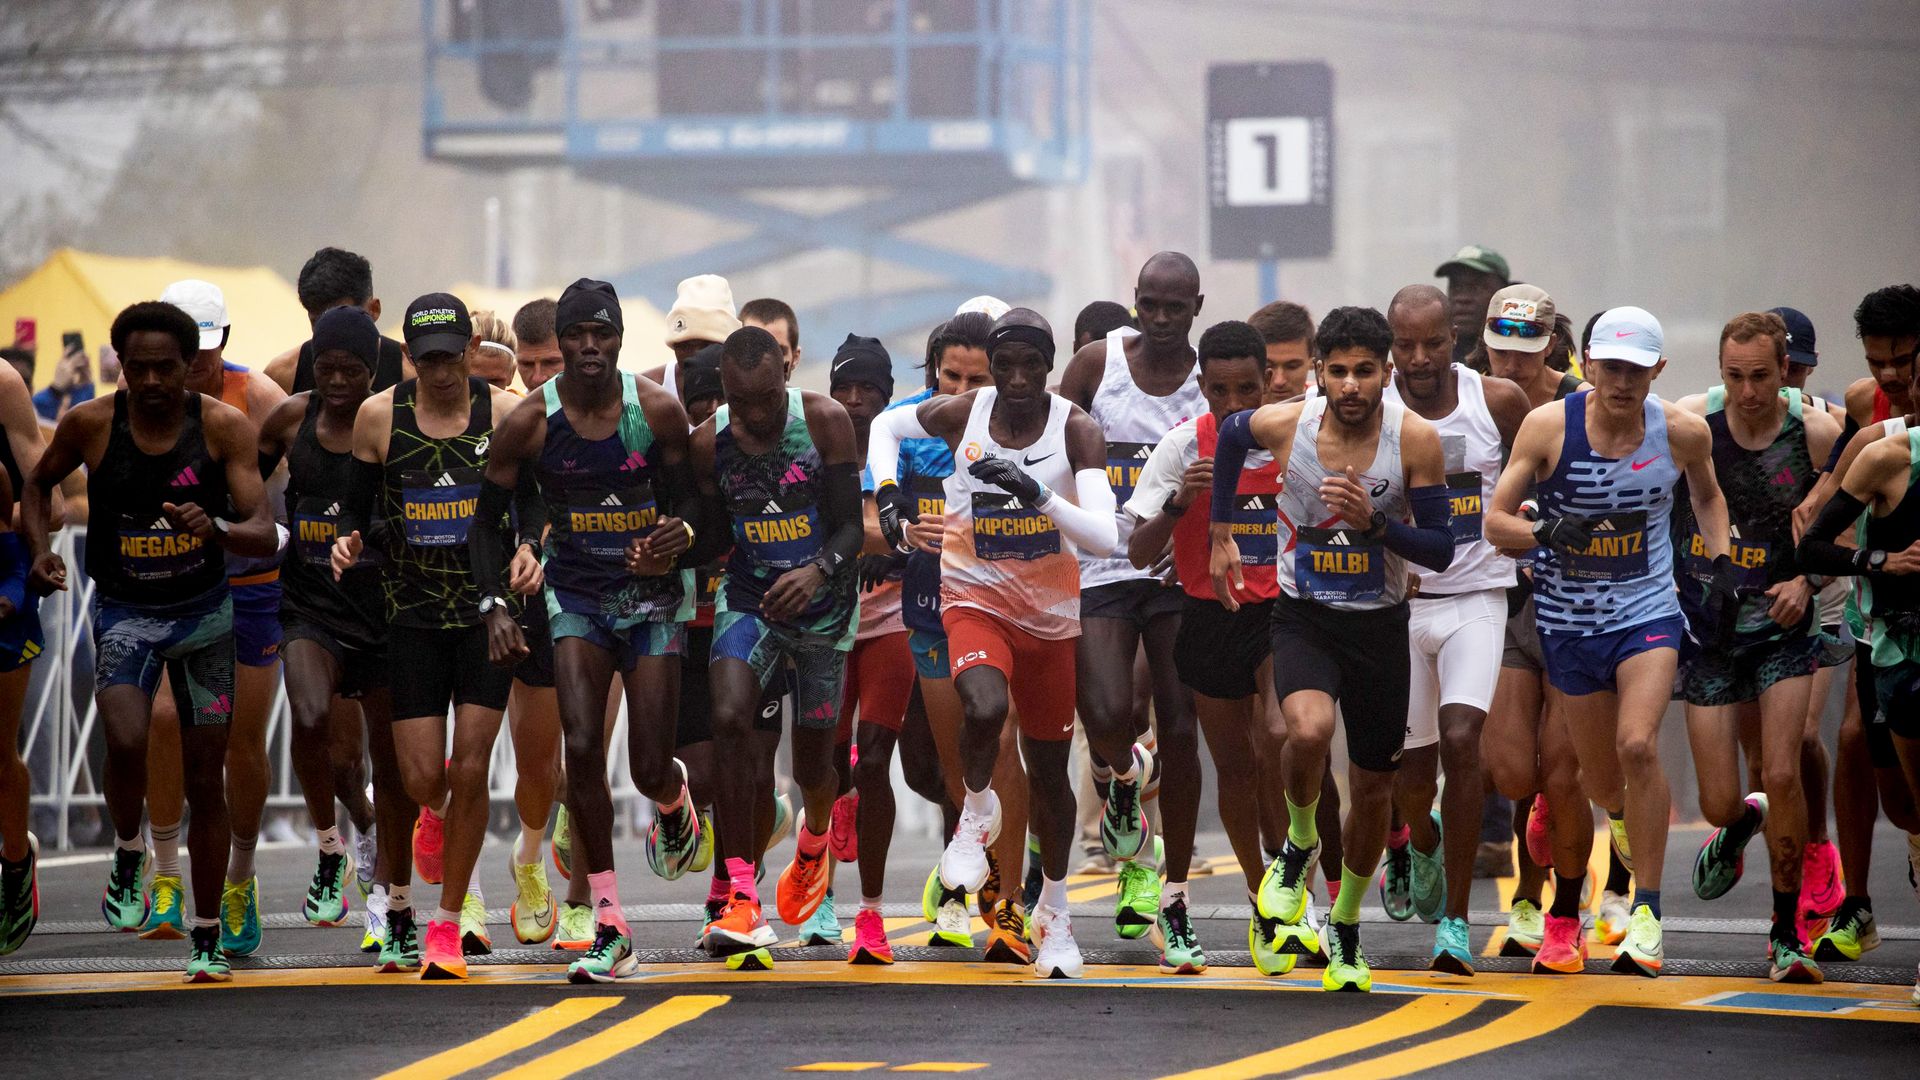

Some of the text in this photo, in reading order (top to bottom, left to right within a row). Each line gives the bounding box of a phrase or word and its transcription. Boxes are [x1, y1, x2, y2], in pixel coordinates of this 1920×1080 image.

[1253, 132, 1278, 191] 1
[411, 313, 457, 326] CHAMPIONSHIPS
[570, 506, 657, 533] BENSON
[744, 514, 812, 543] EVANS
[1310, 550, 1369, 575] TALBI
